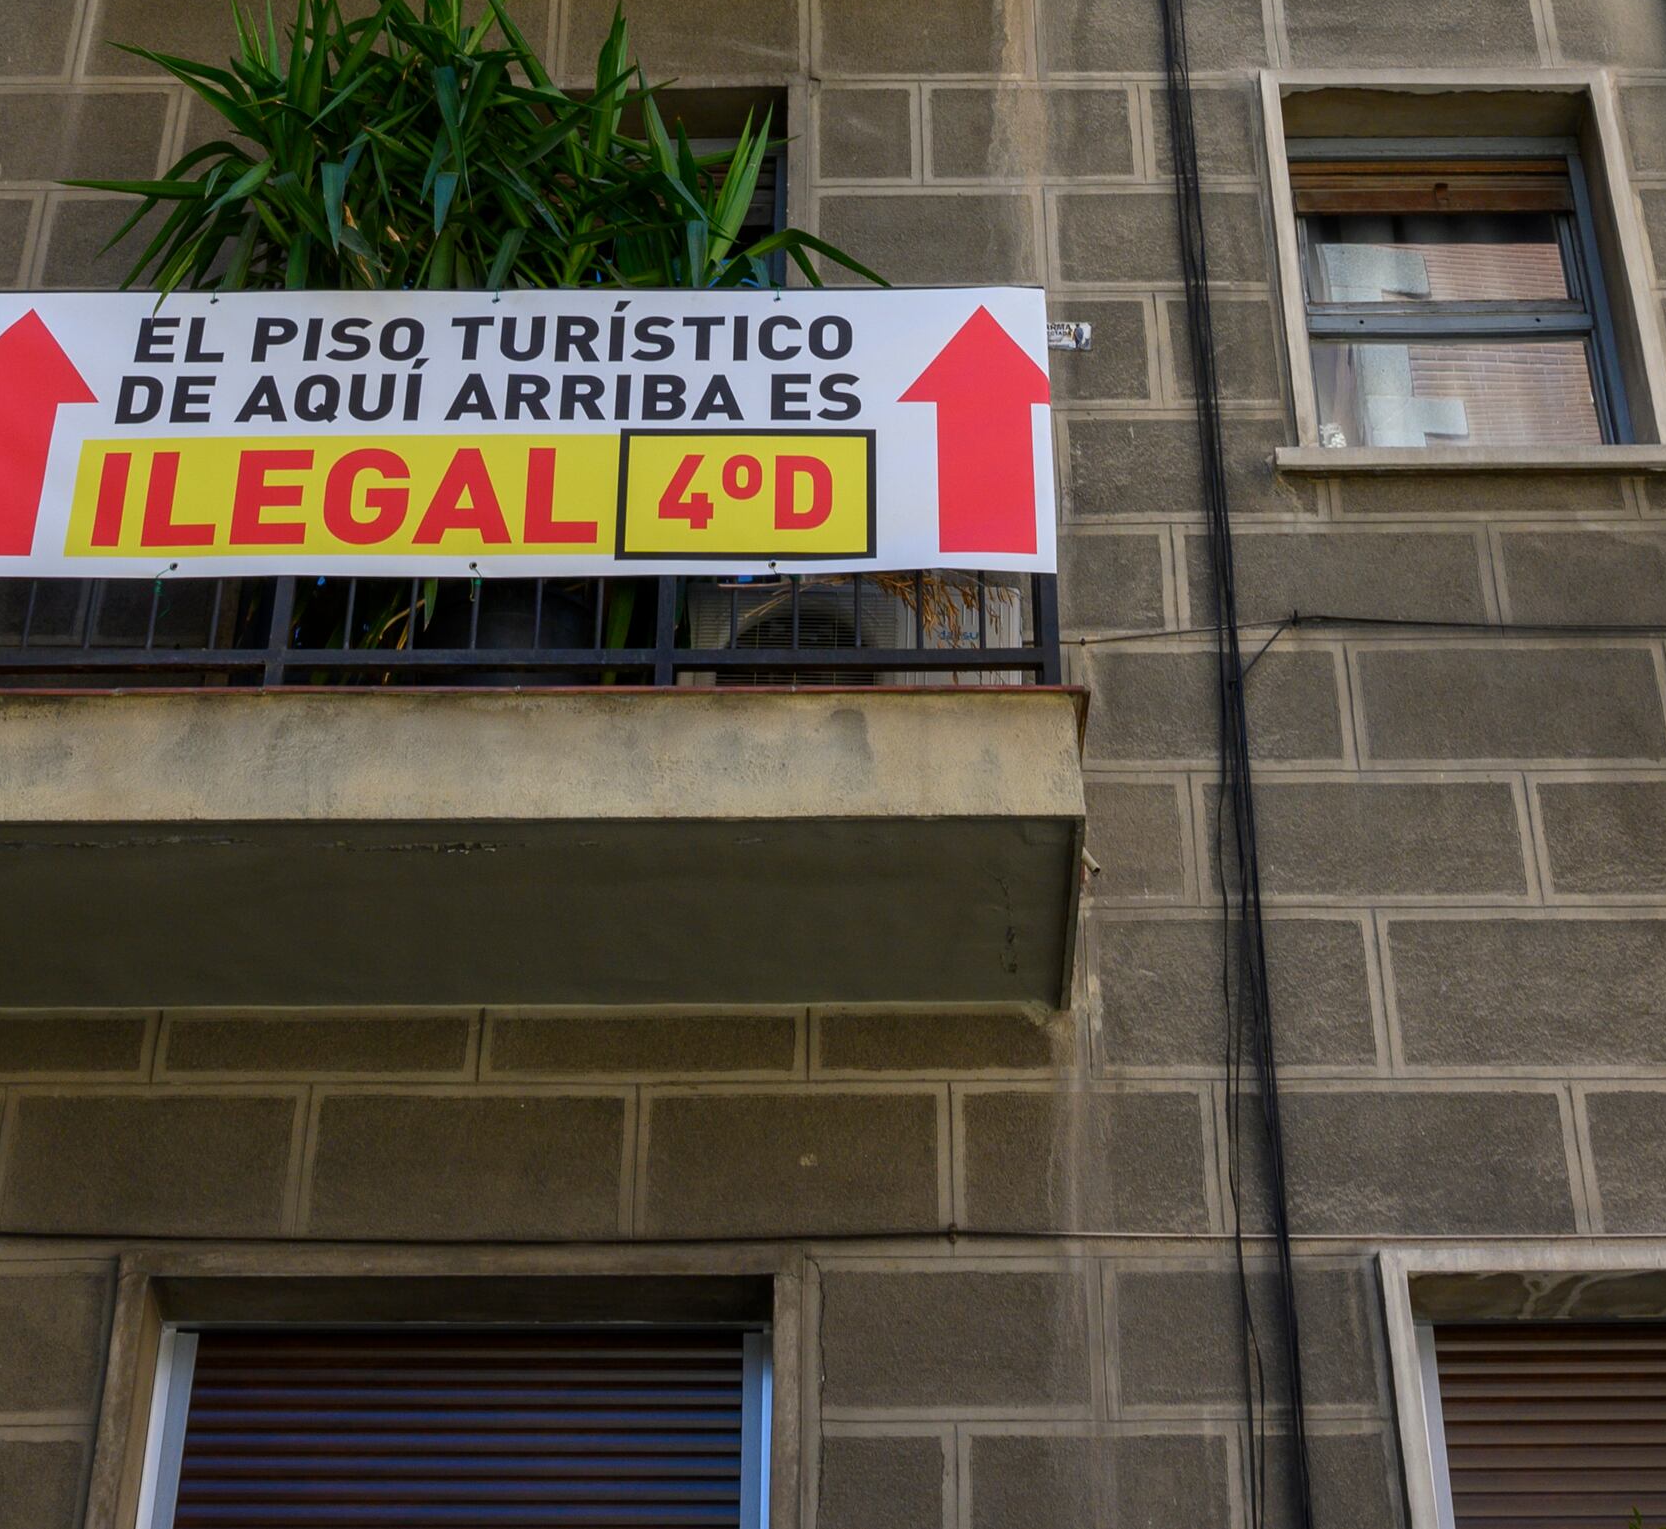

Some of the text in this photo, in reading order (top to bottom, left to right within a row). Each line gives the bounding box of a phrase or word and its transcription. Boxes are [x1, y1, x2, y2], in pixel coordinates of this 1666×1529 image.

[132, 300, 854, 364] EL PISO TURÍSTICO
[113, 358, 863, 425] DE AQUÍ ARRIBA ES
[90, 447, 599, 548] ILEGAL
